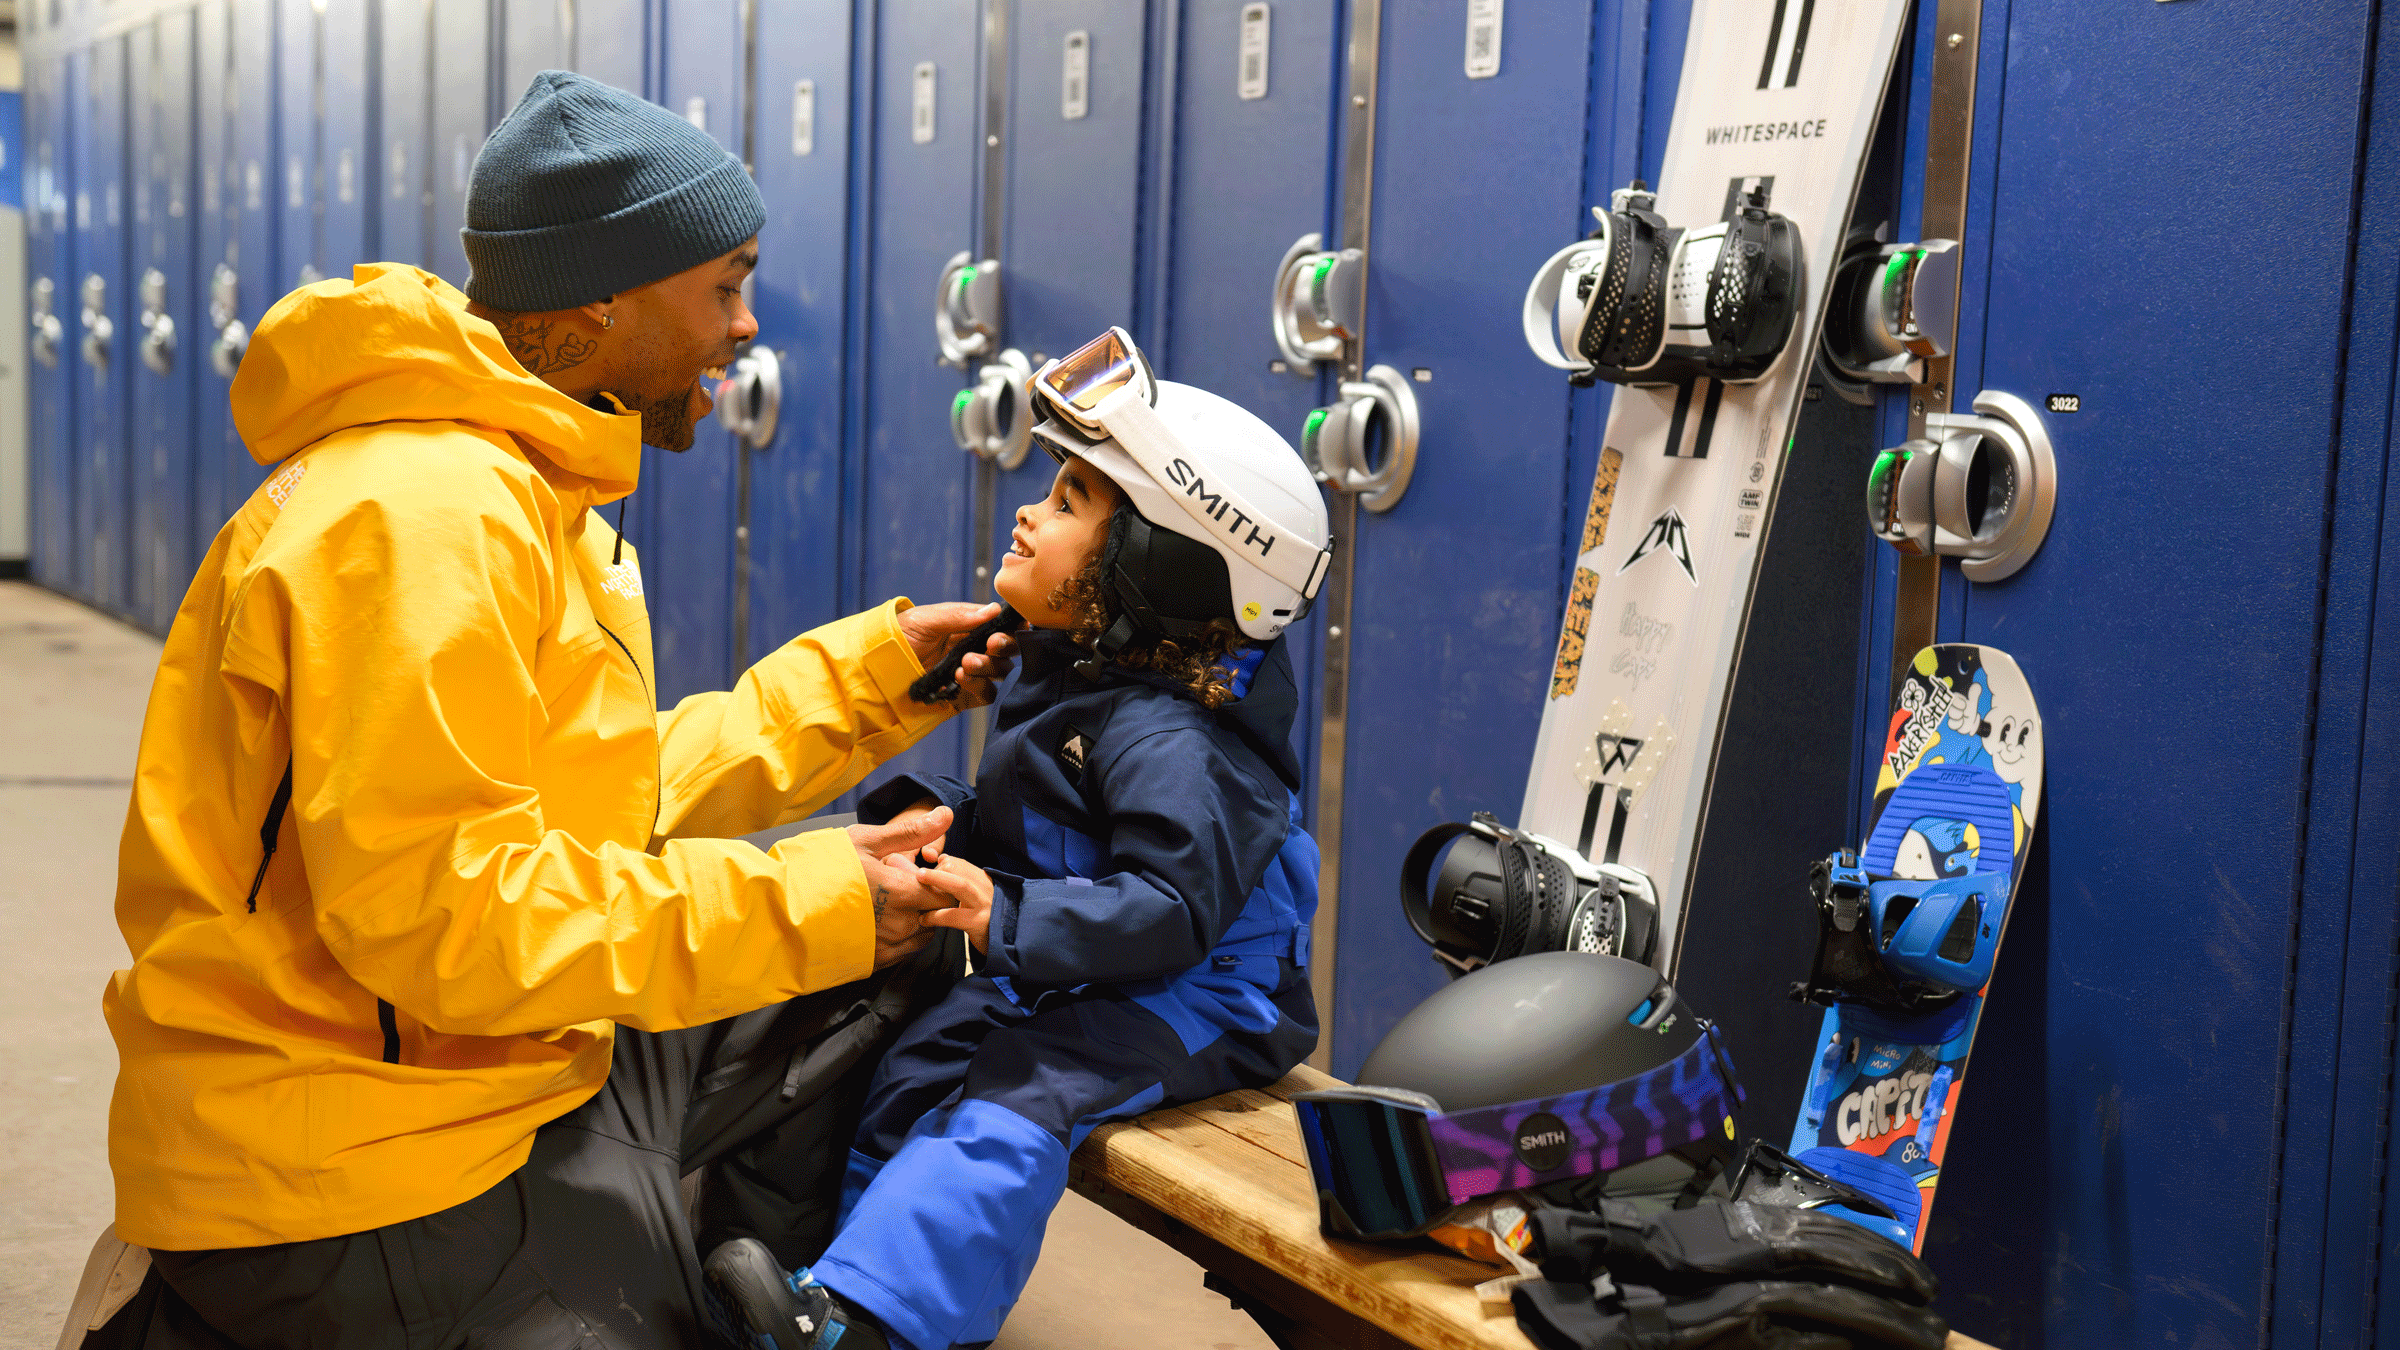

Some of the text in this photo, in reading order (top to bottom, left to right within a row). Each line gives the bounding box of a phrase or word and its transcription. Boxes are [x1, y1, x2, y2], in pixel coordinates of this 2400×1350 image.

[1706, 119, 1826, 145] WHITESPACE
[2051, 397, 2078, 411] 3022
[1165, 457, 1276, 557] SMITH
[1740, 499, 1759, 507] TWIN
[1520, 1130, 1566, 1151] SMITH
